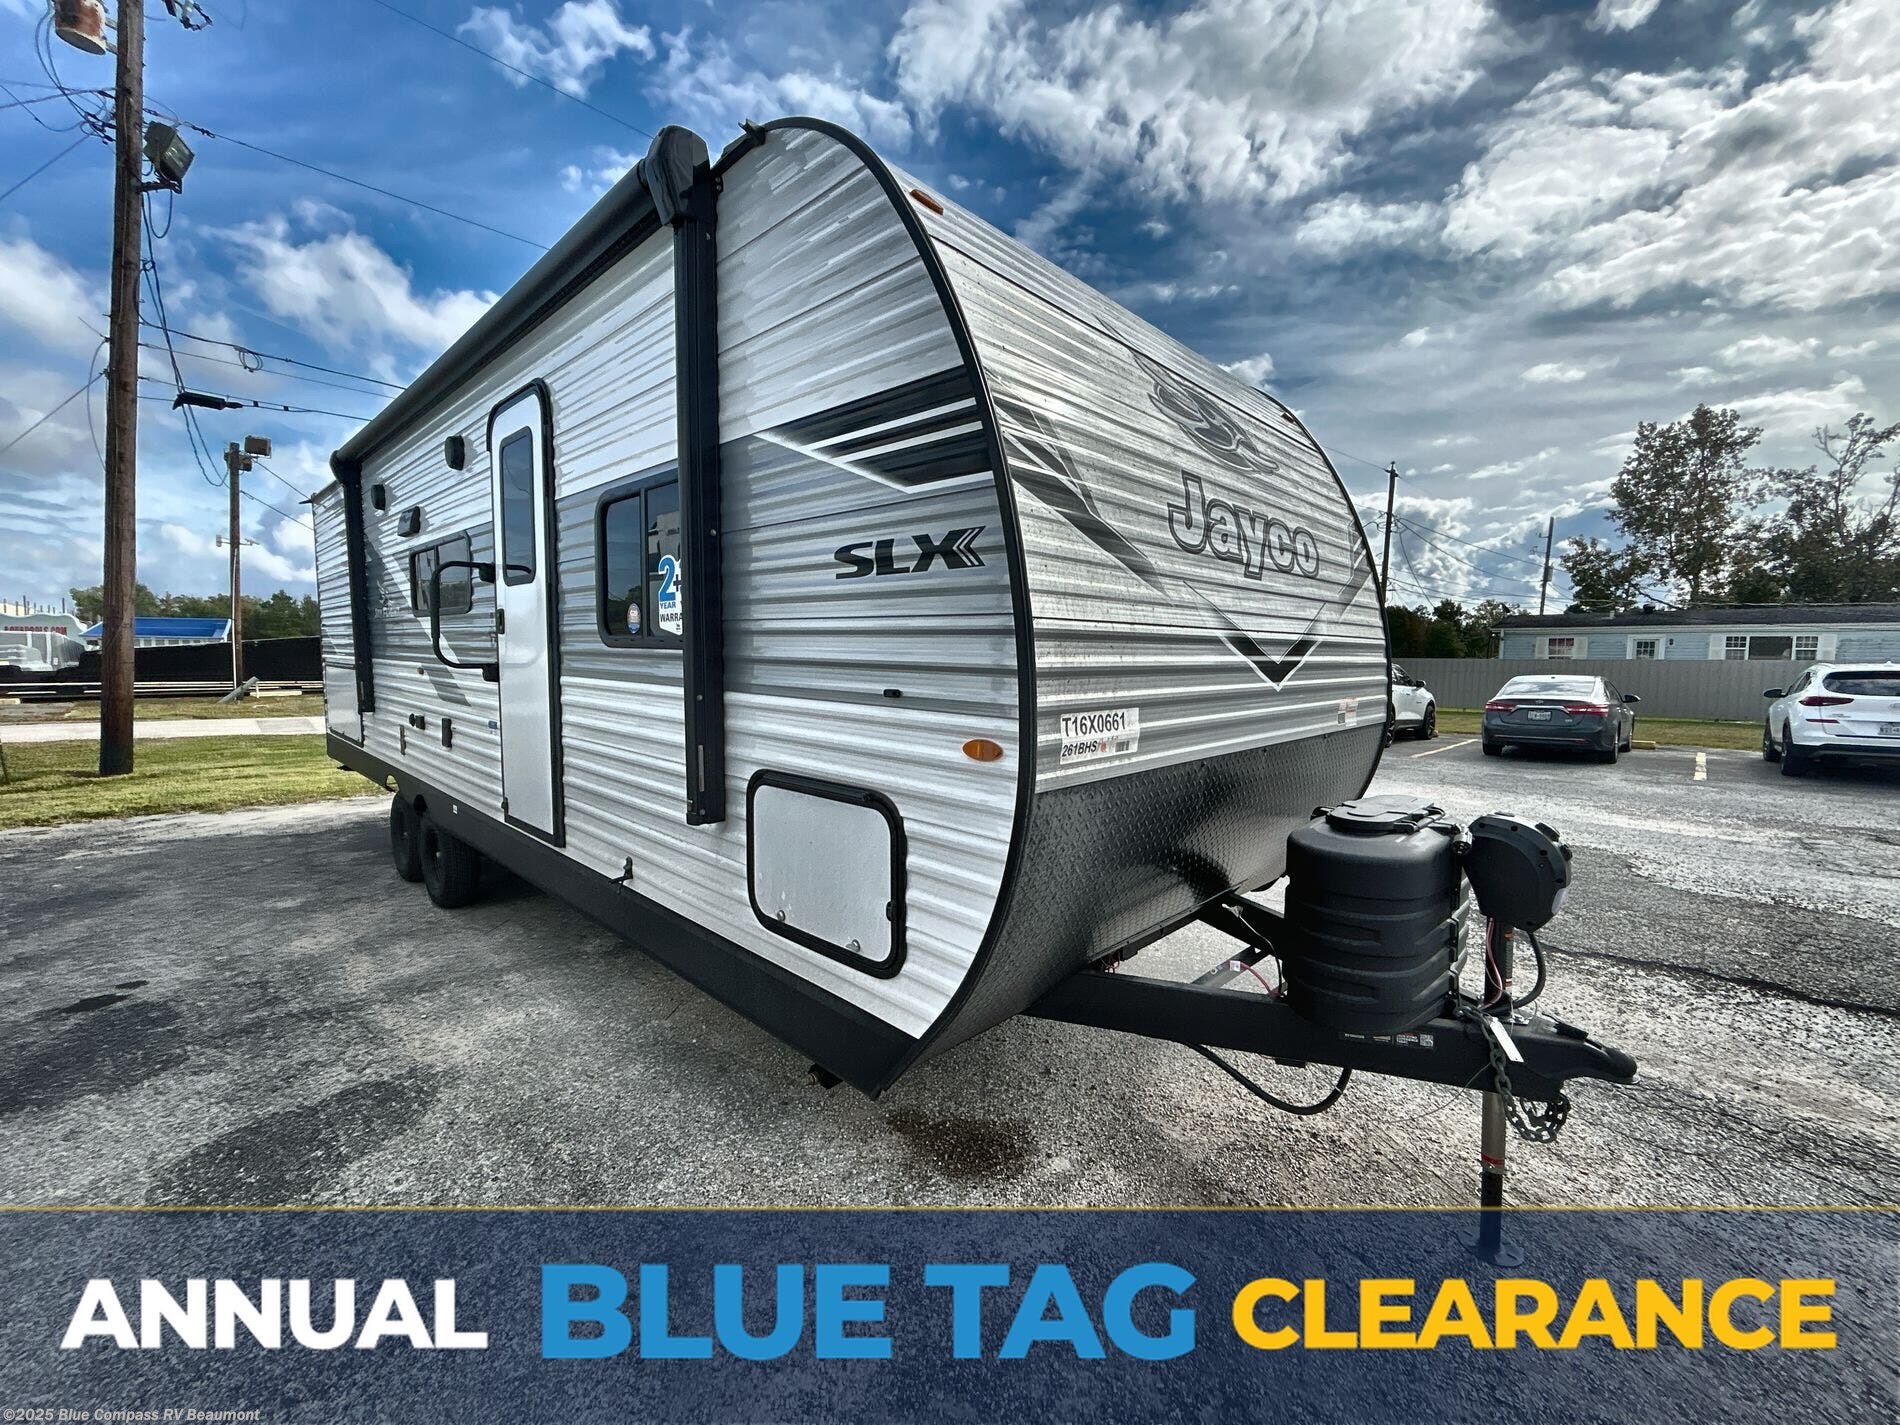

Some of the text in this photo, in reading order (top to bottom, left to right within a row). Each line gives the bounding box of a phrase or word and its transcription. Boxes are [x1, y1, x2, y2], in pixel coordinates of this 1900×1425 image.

[1167, 469, 1320, 581] Jayco
[834, 525, 986, 580] SLX
[660, 601, 677, 610] YEAR
[1062, 711, 1126, 737] T16X0661
[1062, 740, 1098, 757] 261BHS
